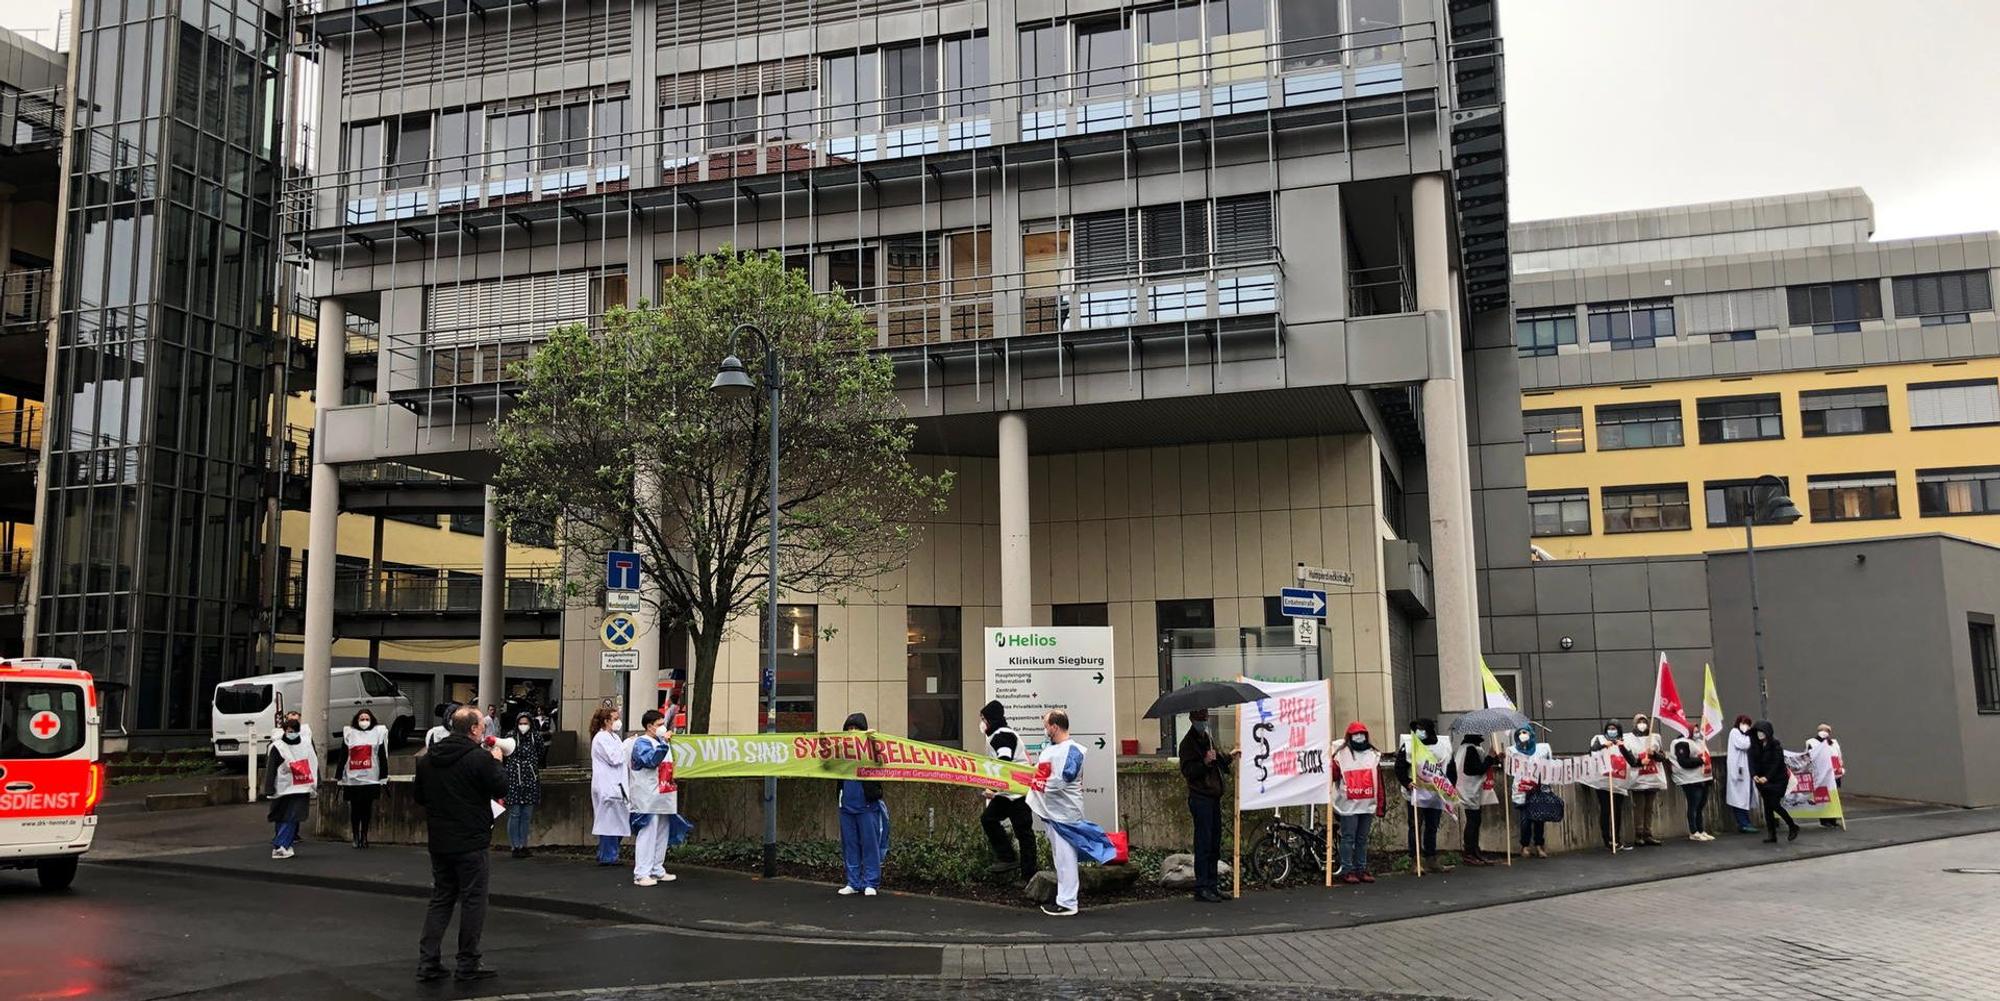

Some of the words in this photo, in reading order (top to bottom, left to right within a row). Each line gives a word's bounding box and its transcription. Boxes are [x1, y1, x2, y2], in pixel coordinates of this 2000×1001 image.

[1008, 633, 1057, 647] Helios
[1009, 656, 1055, 665] Klinikum
[1058, 656, 1104, 667] Siegburg
[698, 736, 741, 762] WIR
[743, 740, 790, 764] SIND
[792, 735, 978, 773] SYSTEMRELEVANT
[955, 774, 968, 783] und
